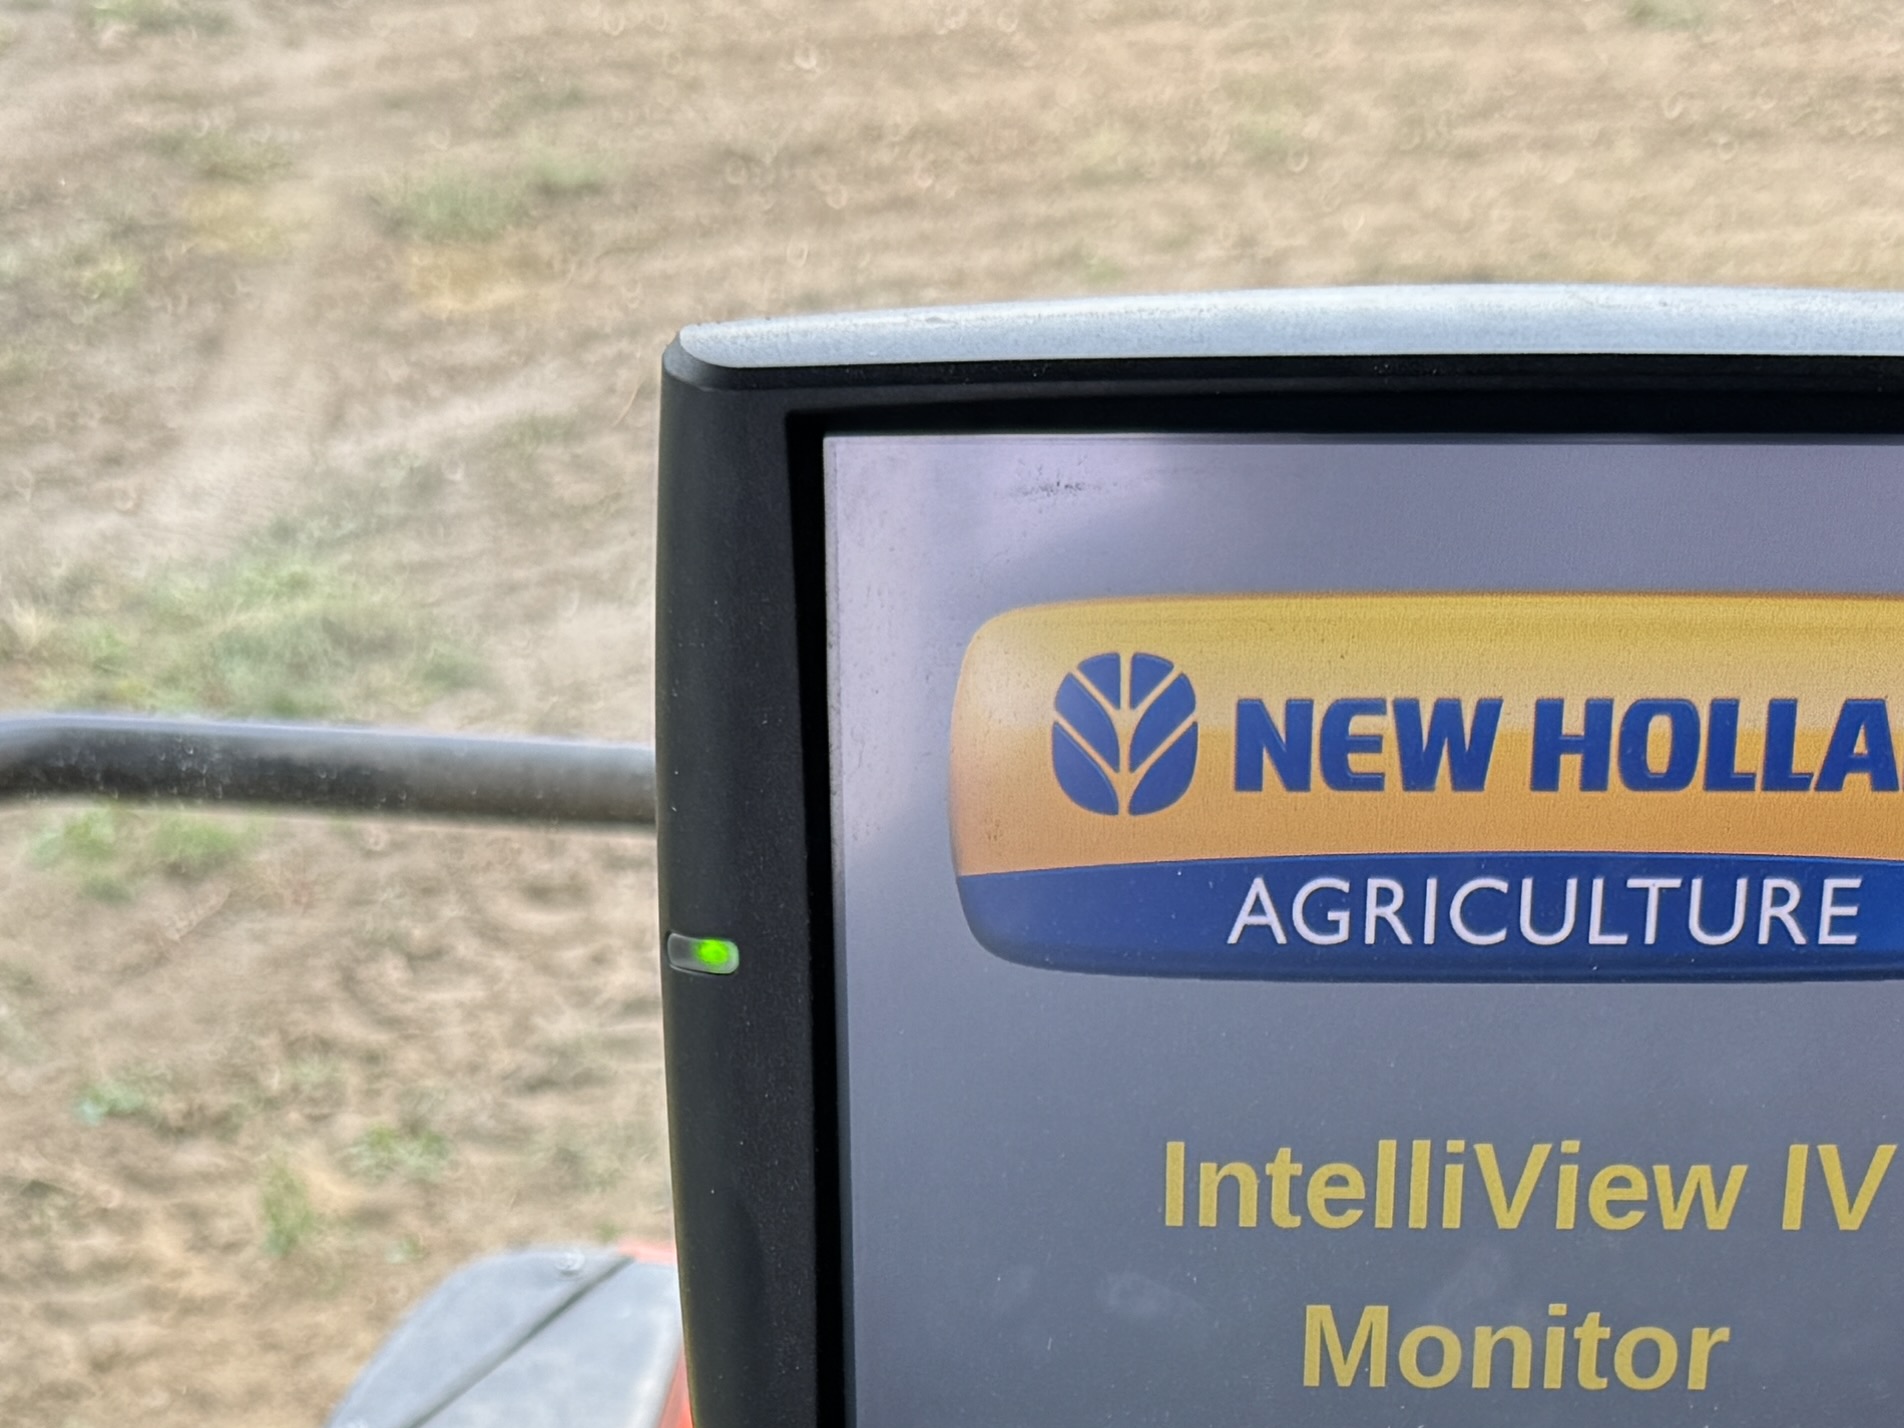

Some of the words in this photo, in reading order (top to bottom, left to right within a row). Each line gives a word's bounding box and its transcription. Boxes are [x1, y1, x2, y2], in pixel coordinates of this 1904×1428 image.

[1232, 696, 1504, 793] NEW
[1225, 876, 1864, 947] AGRICULTURE
[1161, 1139, 1748, 1232] IntelliView
[1781, 1143, 1898, 1232] IV
[1300, 1303, 1731, 1393] Monitor
